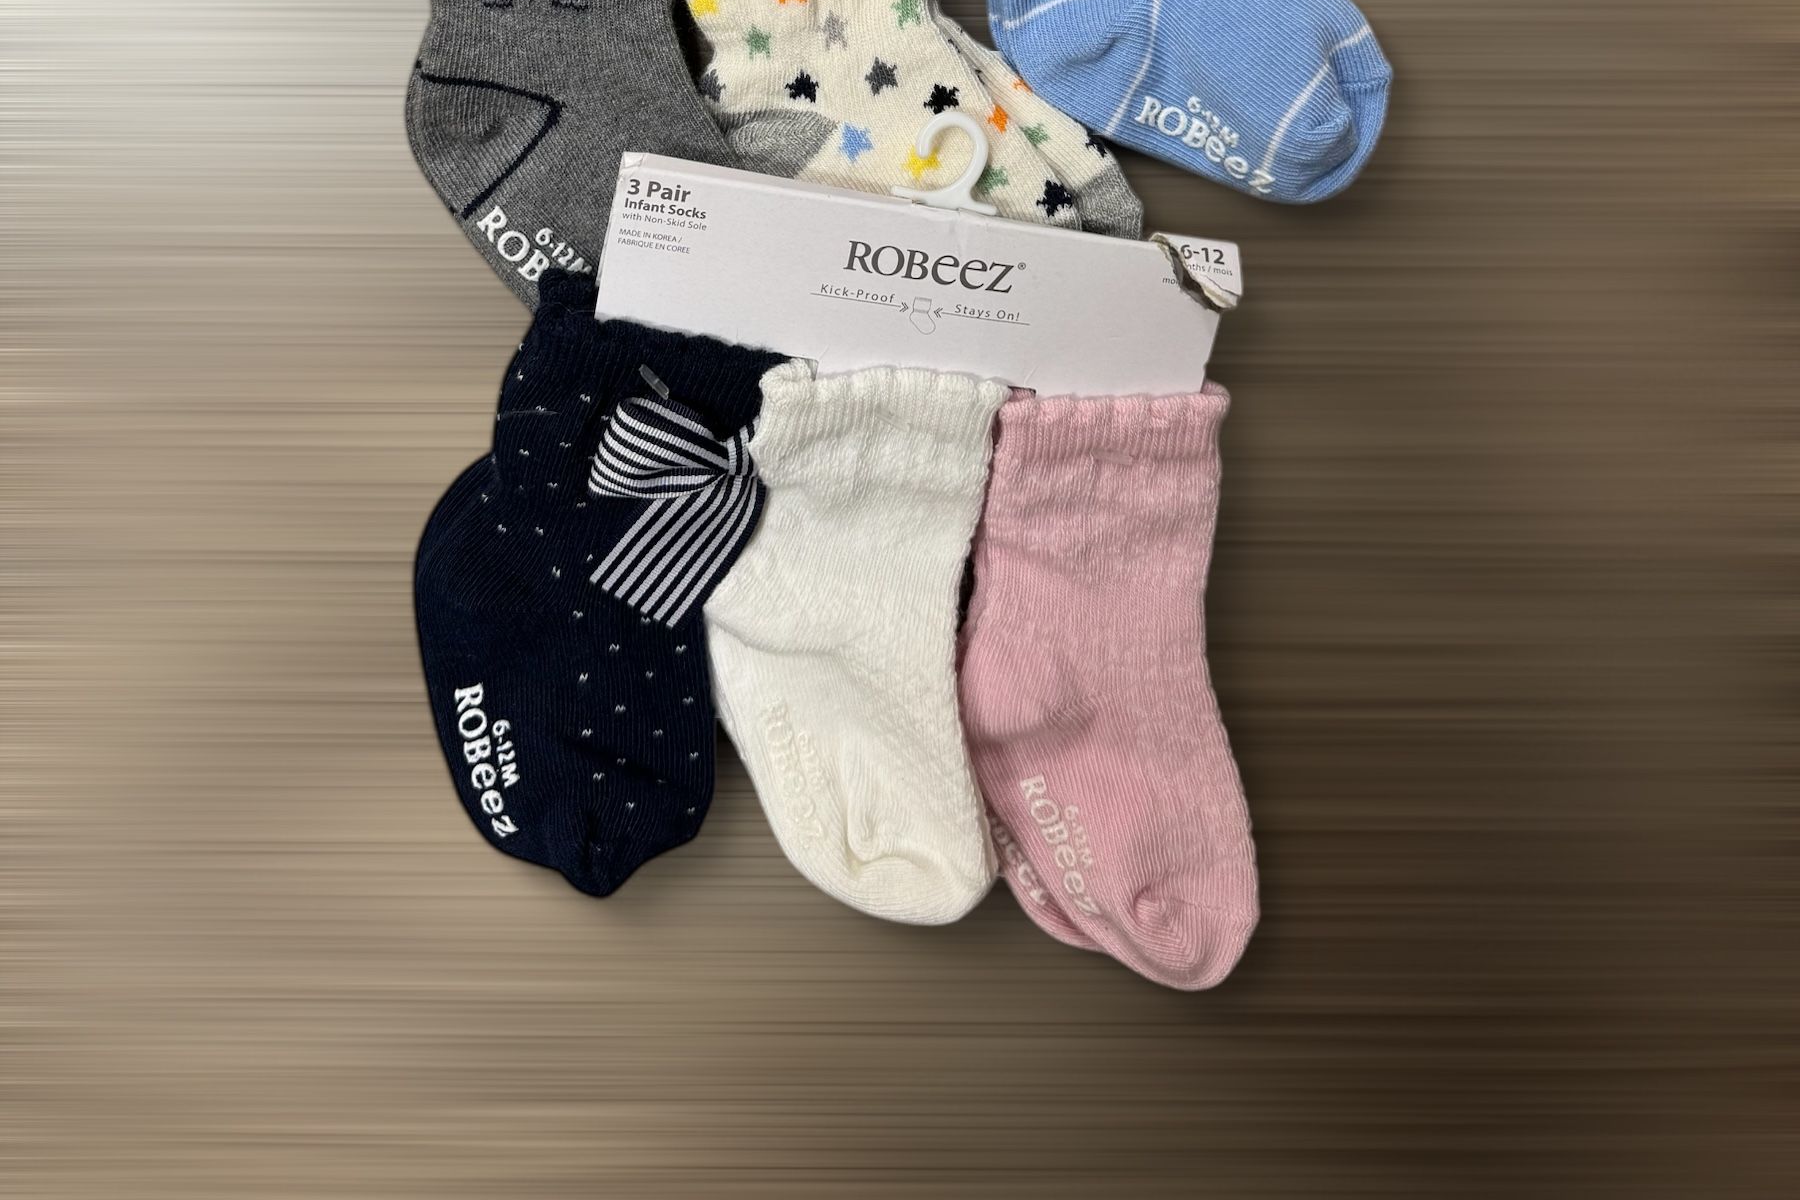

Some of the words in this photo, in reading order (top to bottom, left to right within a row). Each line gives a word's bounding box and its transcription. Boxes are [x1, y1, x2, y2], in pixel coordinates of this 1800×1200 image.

[627, 179, 640, 195] 3
[647, 181, 691, 202] Pair
[624, 198, 665, 213] Infant
[668, 204, 707, 219] Socks
[622, 212, 642, 221] with
[644, 214, 686, 228] Non-Skid
[688, 221, 707, 231] Sole
[617, 237, 653, 248] FABRIQUE
[619, 228, 641, 238] MADE
[643, 231, 651, 239] IN
[652, 233, 677, 242] KOREA
[1180, 244, 1225, 265] 6-12
[1213, 266, 1233, 276] mois
[820, 283, 896, 304] Kick-Proof
[954, 304, 991, 319] Stays
[996, 309, 1021, 322] On!
[454, 682, 519, 838] ROBeez
[492, 719, 520, 788] 6-12M
